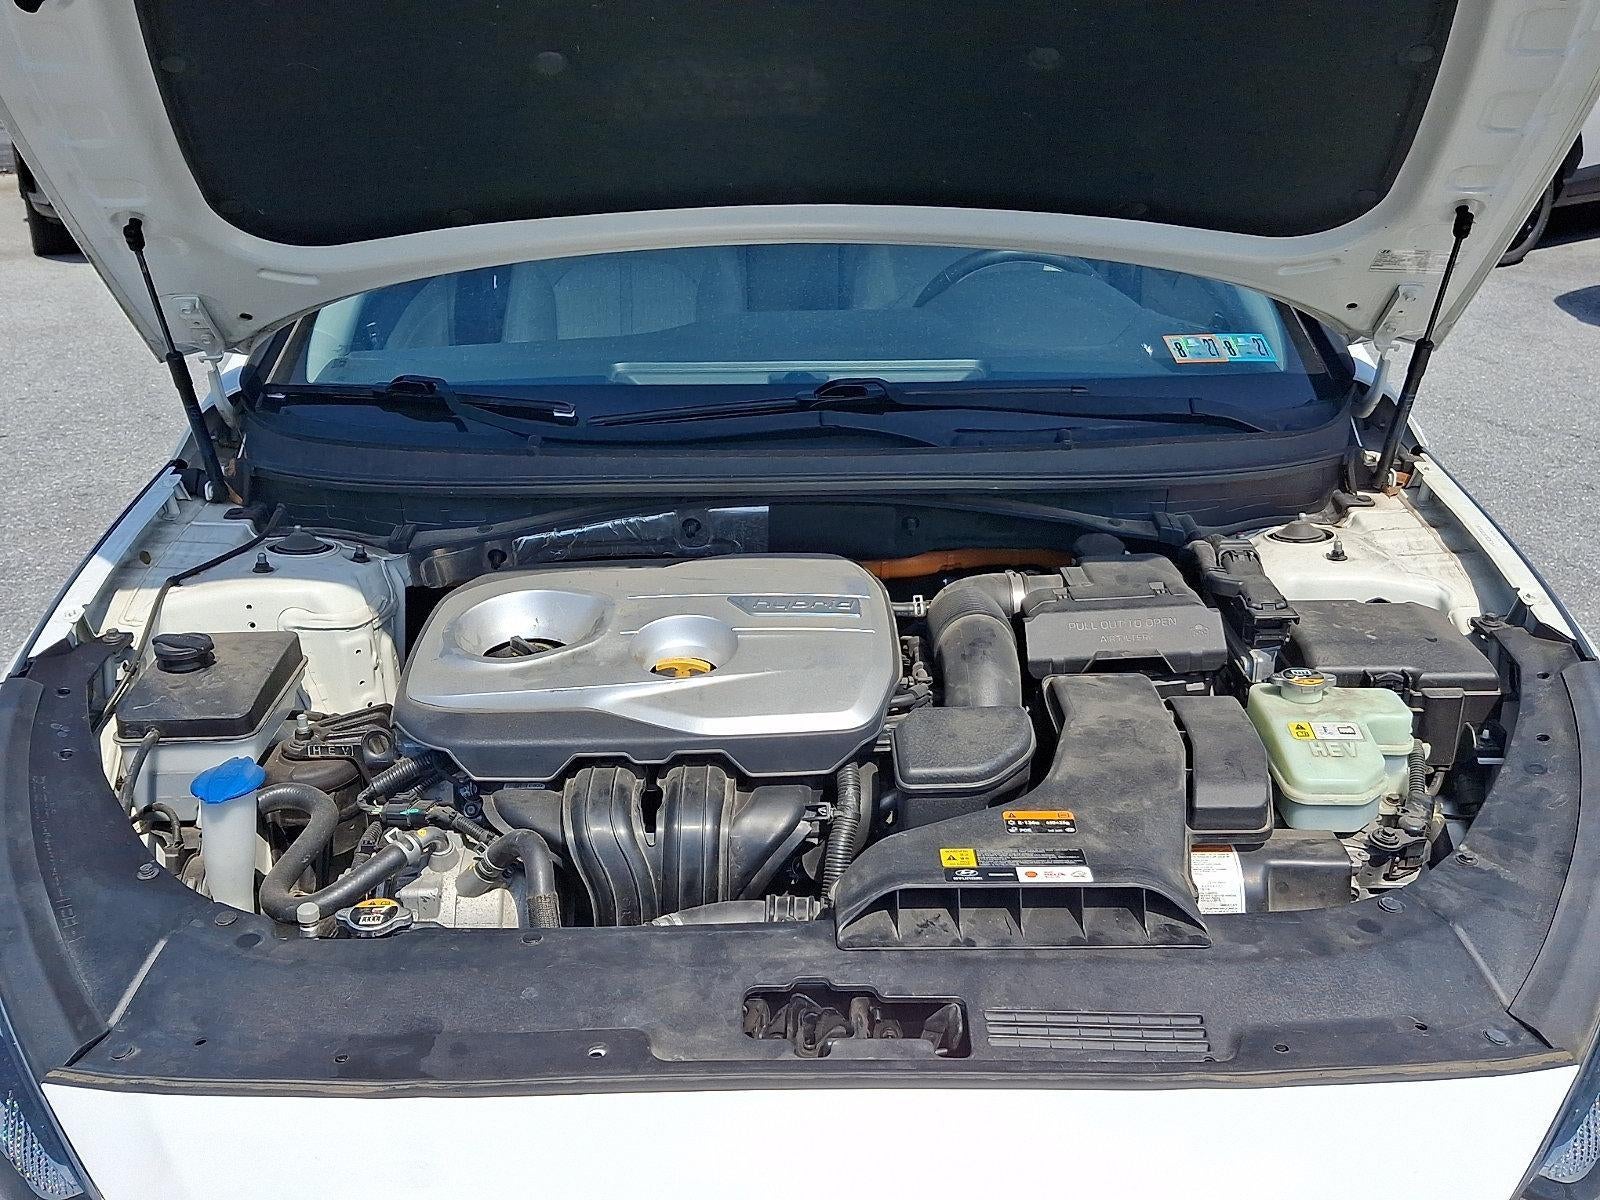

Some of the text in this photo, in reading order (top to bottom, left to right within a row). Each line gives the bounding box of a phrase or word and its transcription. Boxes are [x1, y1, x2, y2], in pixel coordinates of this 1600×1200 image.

[1173, 338, 1220, 358] 8 27
[1223, 337, 1270, 357] 8 27
[1068, 616, 1177, 631] PULL OUT TO OPEN
[312, 746, 350, 756] HEV
[1308, 741, 1358, 758] HEV
